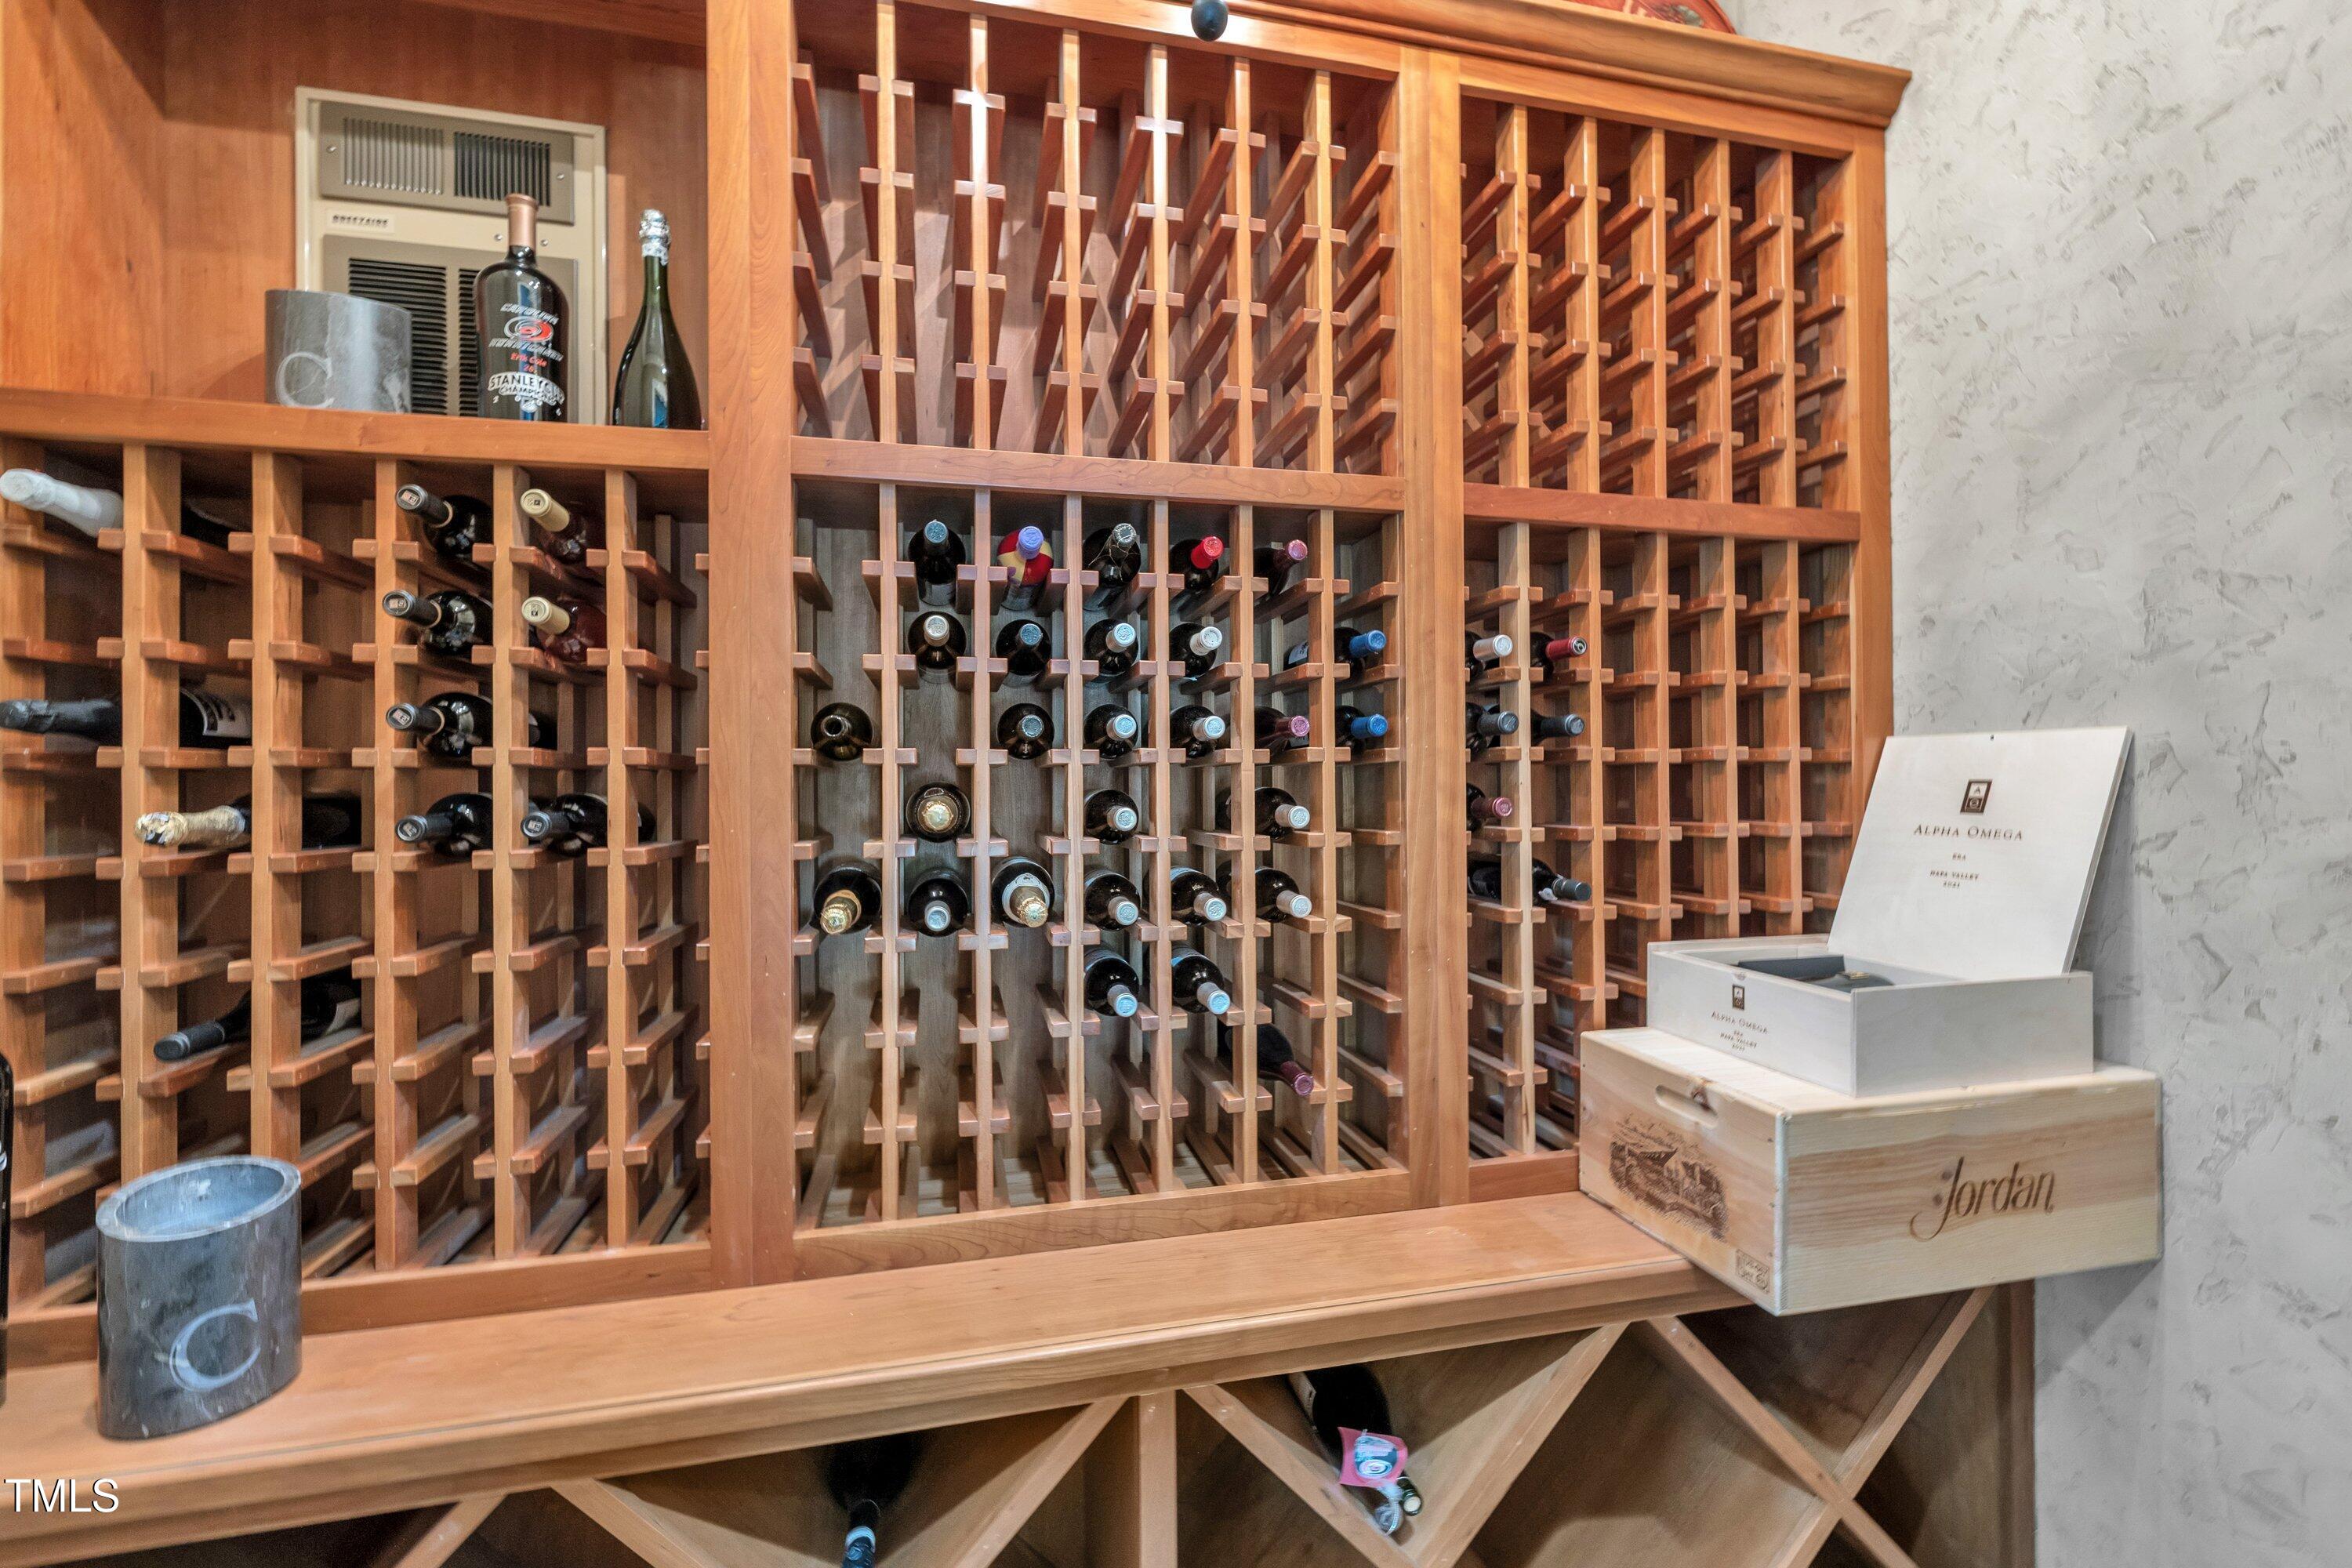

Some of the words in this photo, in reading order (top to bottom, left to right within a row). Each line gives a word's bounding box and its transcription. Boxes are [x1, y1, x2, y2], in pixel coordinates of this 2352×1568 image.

[1913, 824, 1959, 837] ALPHA
[1967, 826, 2023, 841] OMEGA
[1909, 1156, 2055, 1242] Jordan
[169, 1298, 261, 1392] C
